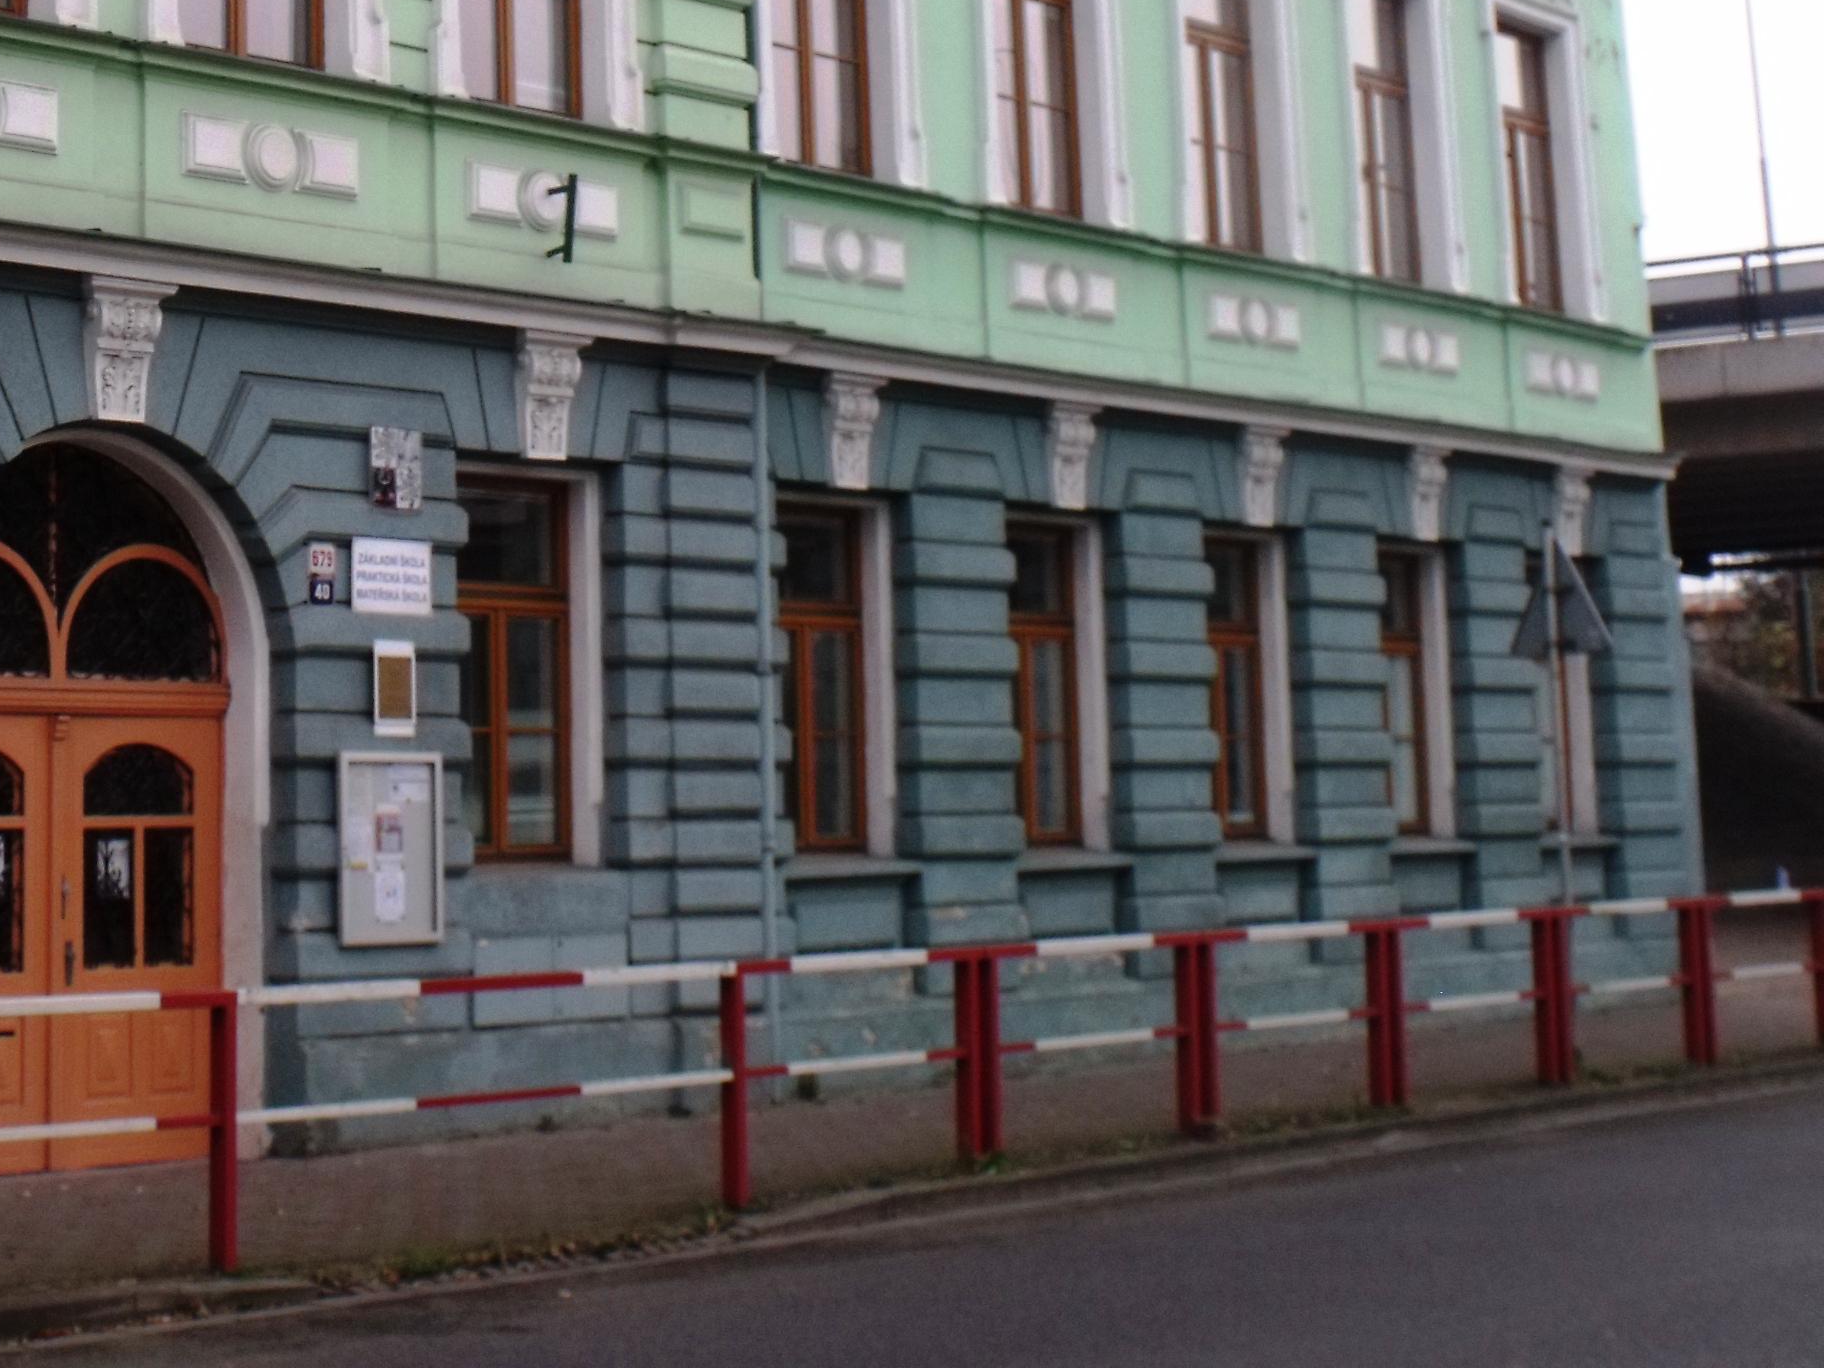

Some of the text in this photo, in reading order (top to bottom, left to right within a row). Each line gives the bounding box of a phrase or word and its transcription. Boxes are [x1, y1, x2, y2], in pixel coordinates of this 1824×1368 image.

[312, 550, 333, 567] 679
[400, 554, 426, 568] ŠKOLA
[315, 583, 330, 600] 40
